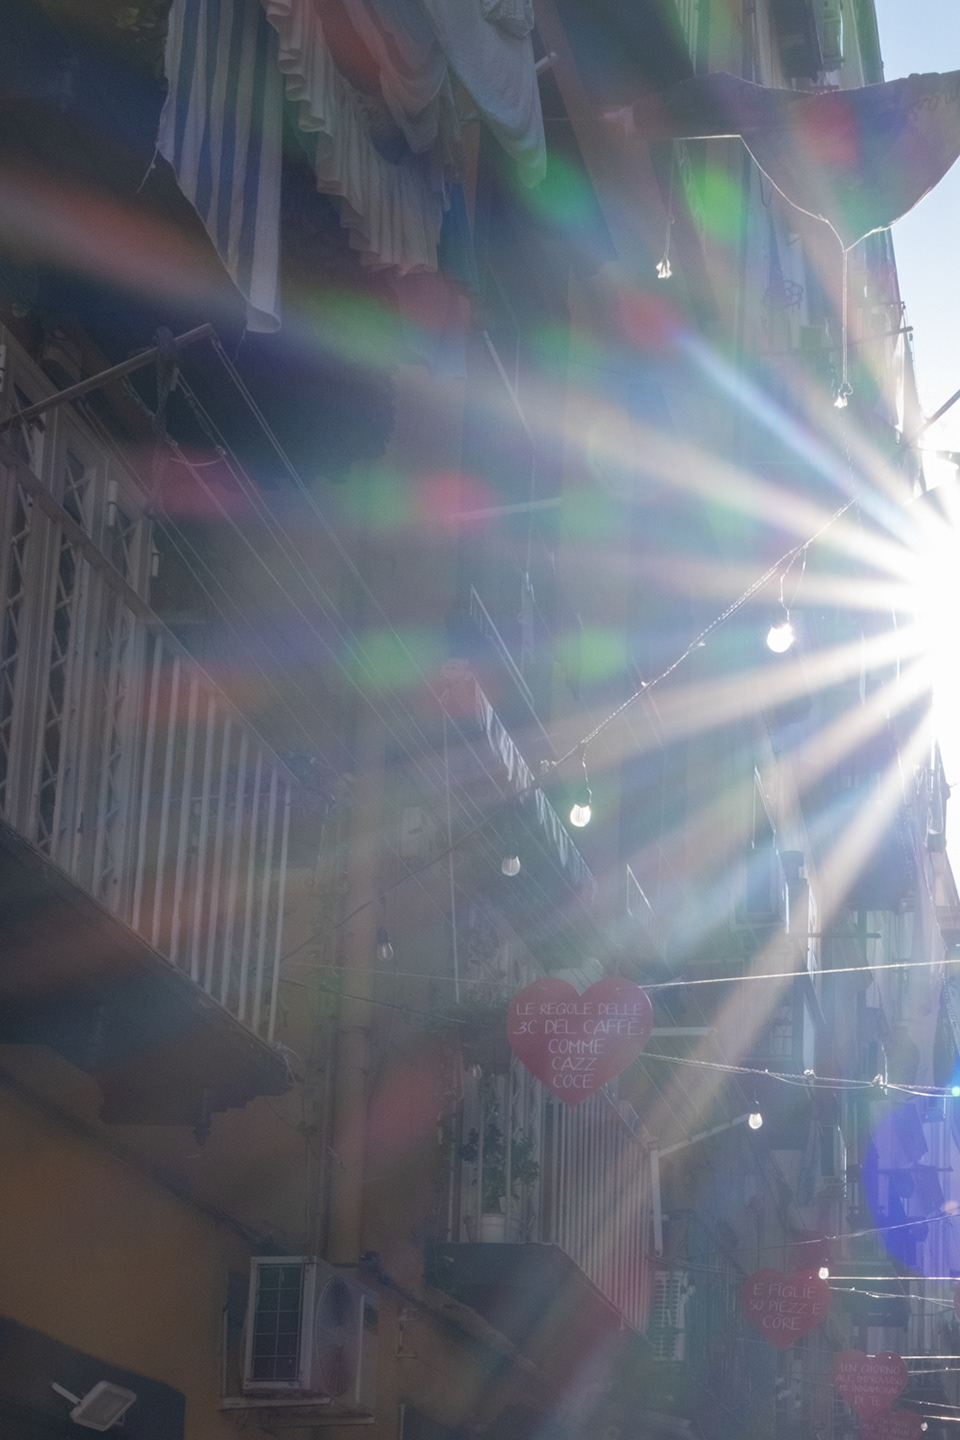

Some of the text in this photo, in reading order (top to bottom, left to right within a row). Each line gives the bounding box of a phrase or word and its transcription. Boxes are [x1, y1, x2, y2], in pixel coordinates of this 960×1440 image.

[516, 1002, 643, 1016] LE REGOLE DELLE
[513, 1017, 645, 1036] 3C DEL CAFFÈ:
[548, 1038, 606, 1054] COMME
[551, 1057, 598, 1071] CAZZ
[552, 1073, 595, 1088] COCE
[753, 1282, 818, 1299] E FIGLIE
[861, 1364, 900, 1375] GIORNO
